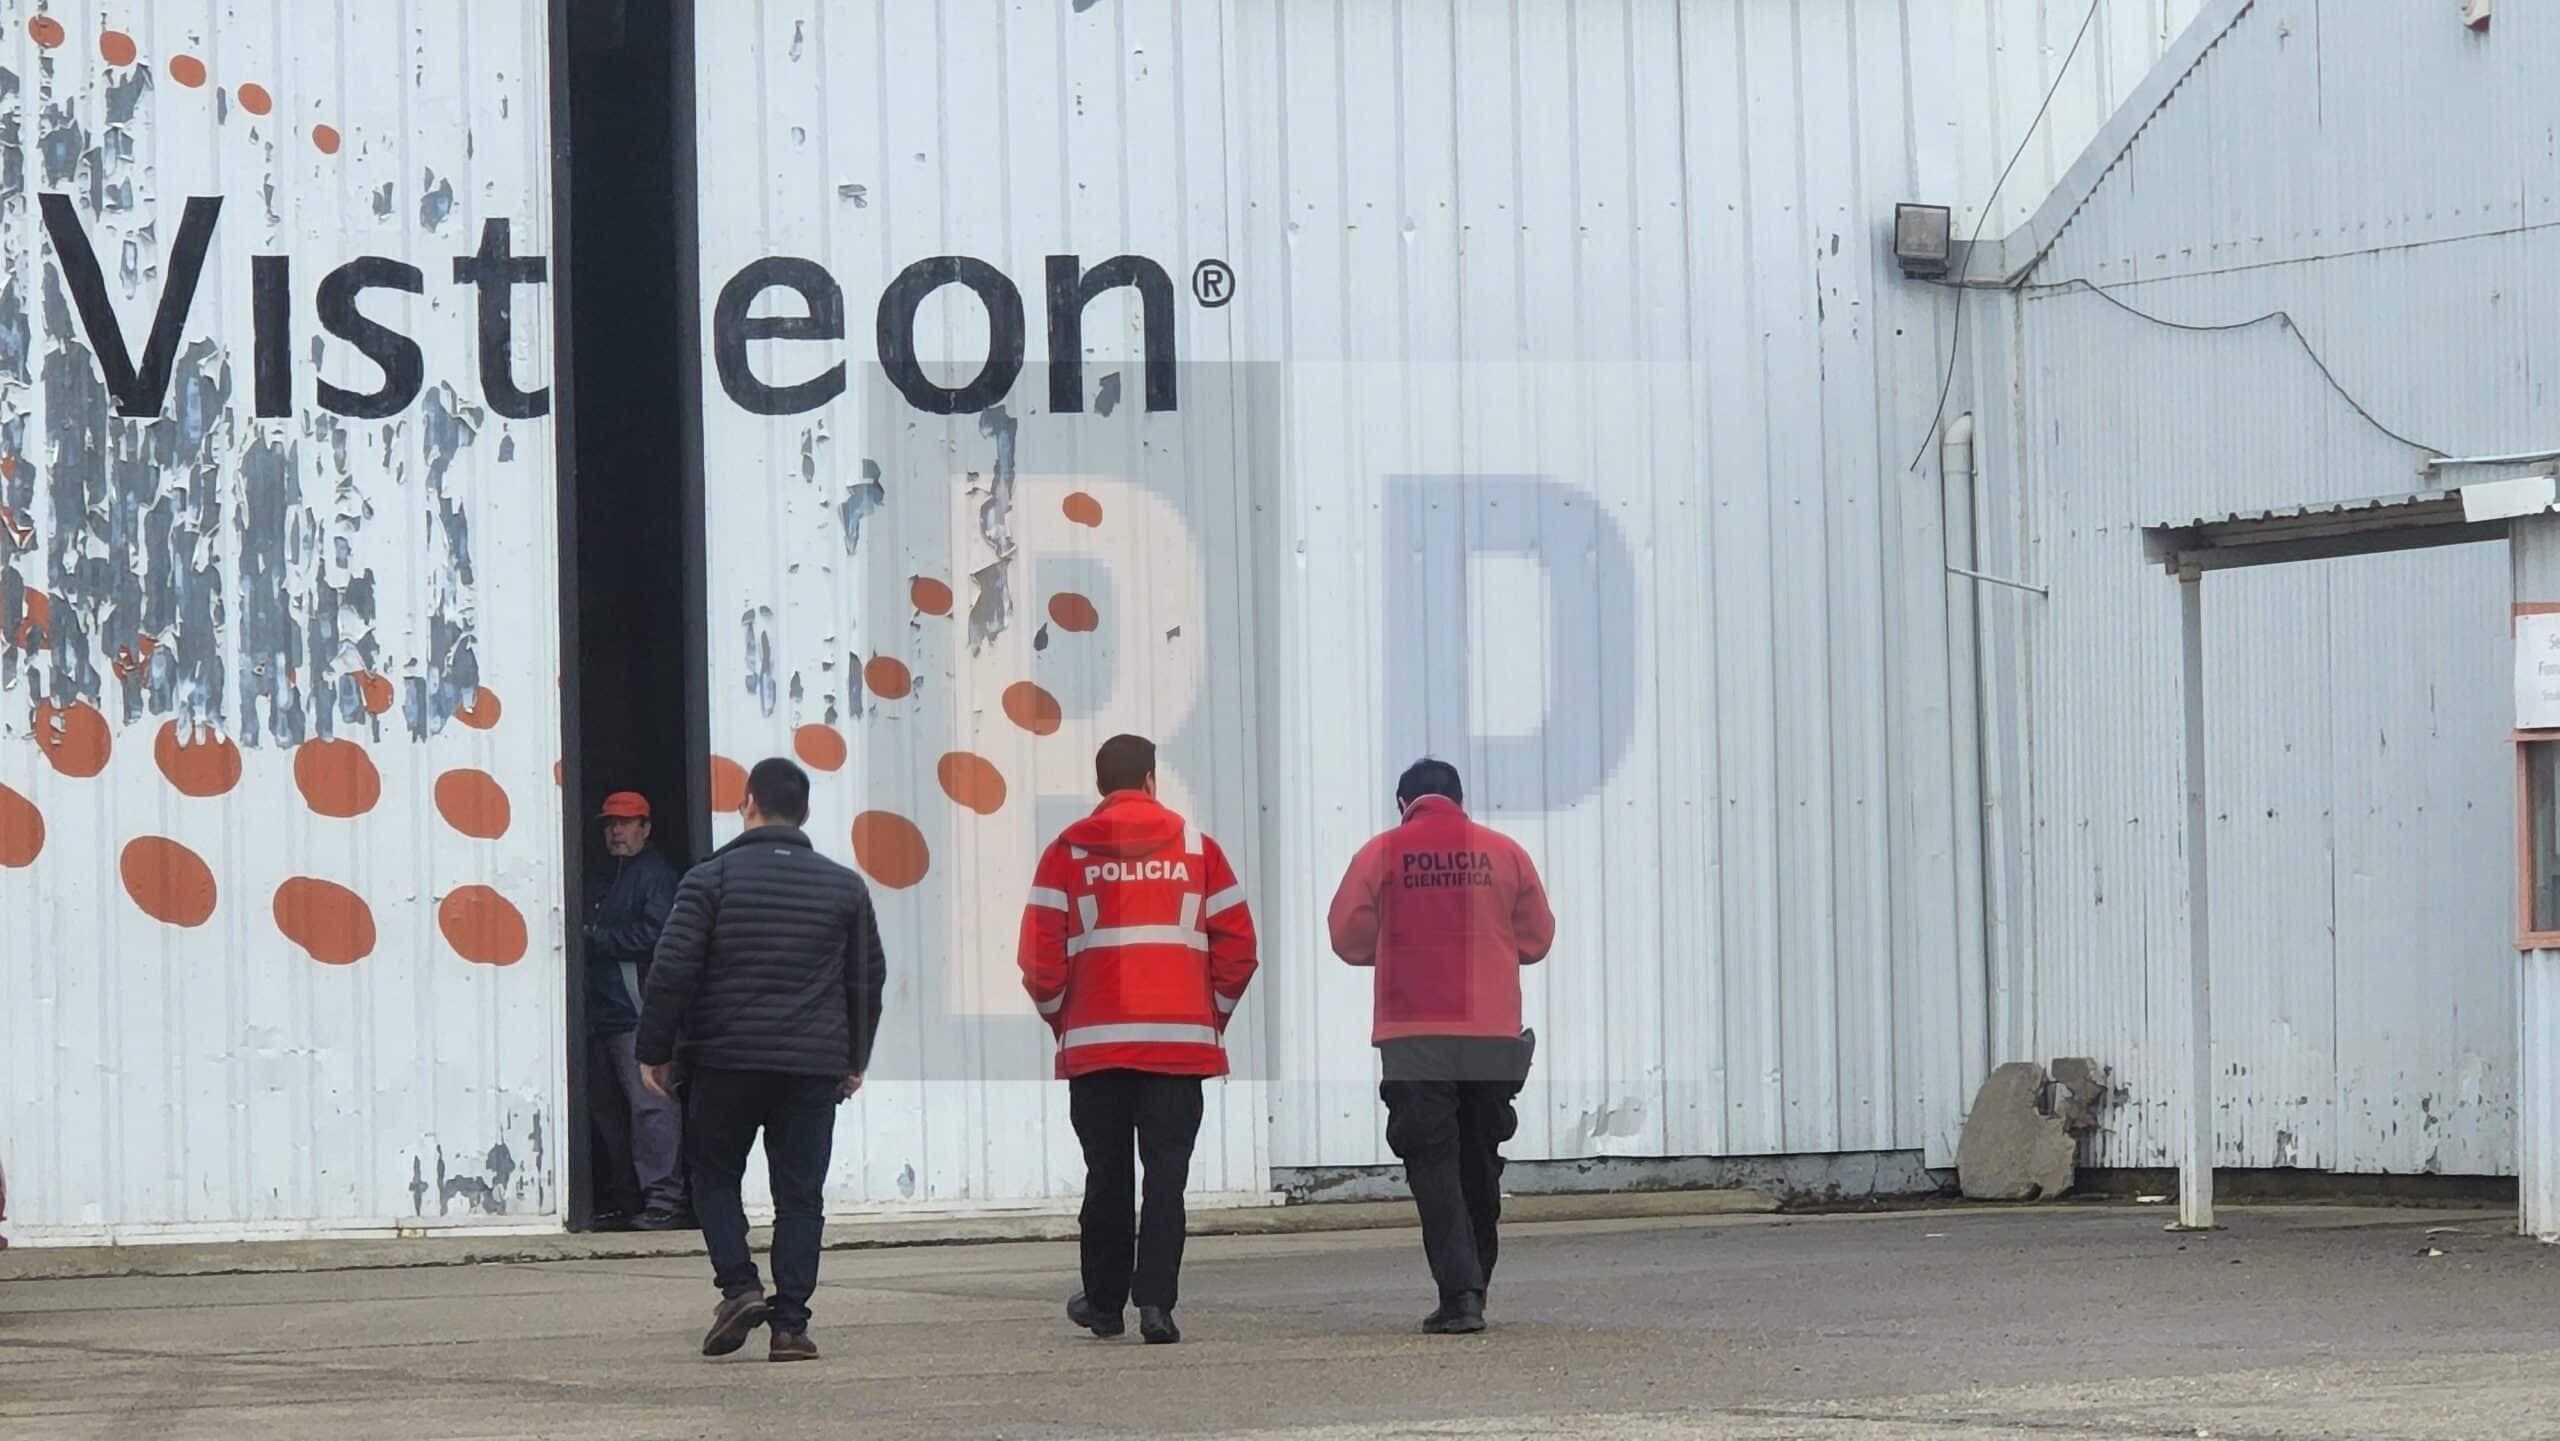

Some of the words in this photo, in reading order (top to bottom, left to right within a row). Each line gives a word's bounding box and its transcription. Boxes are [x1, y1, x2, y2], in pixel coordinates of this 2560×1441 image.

[1084, 860, 1190, 886] POLICIA
[1403, 851, 1493, 873] POLICIA
[1403, 871, 1493, 889] CIENTIFICA
